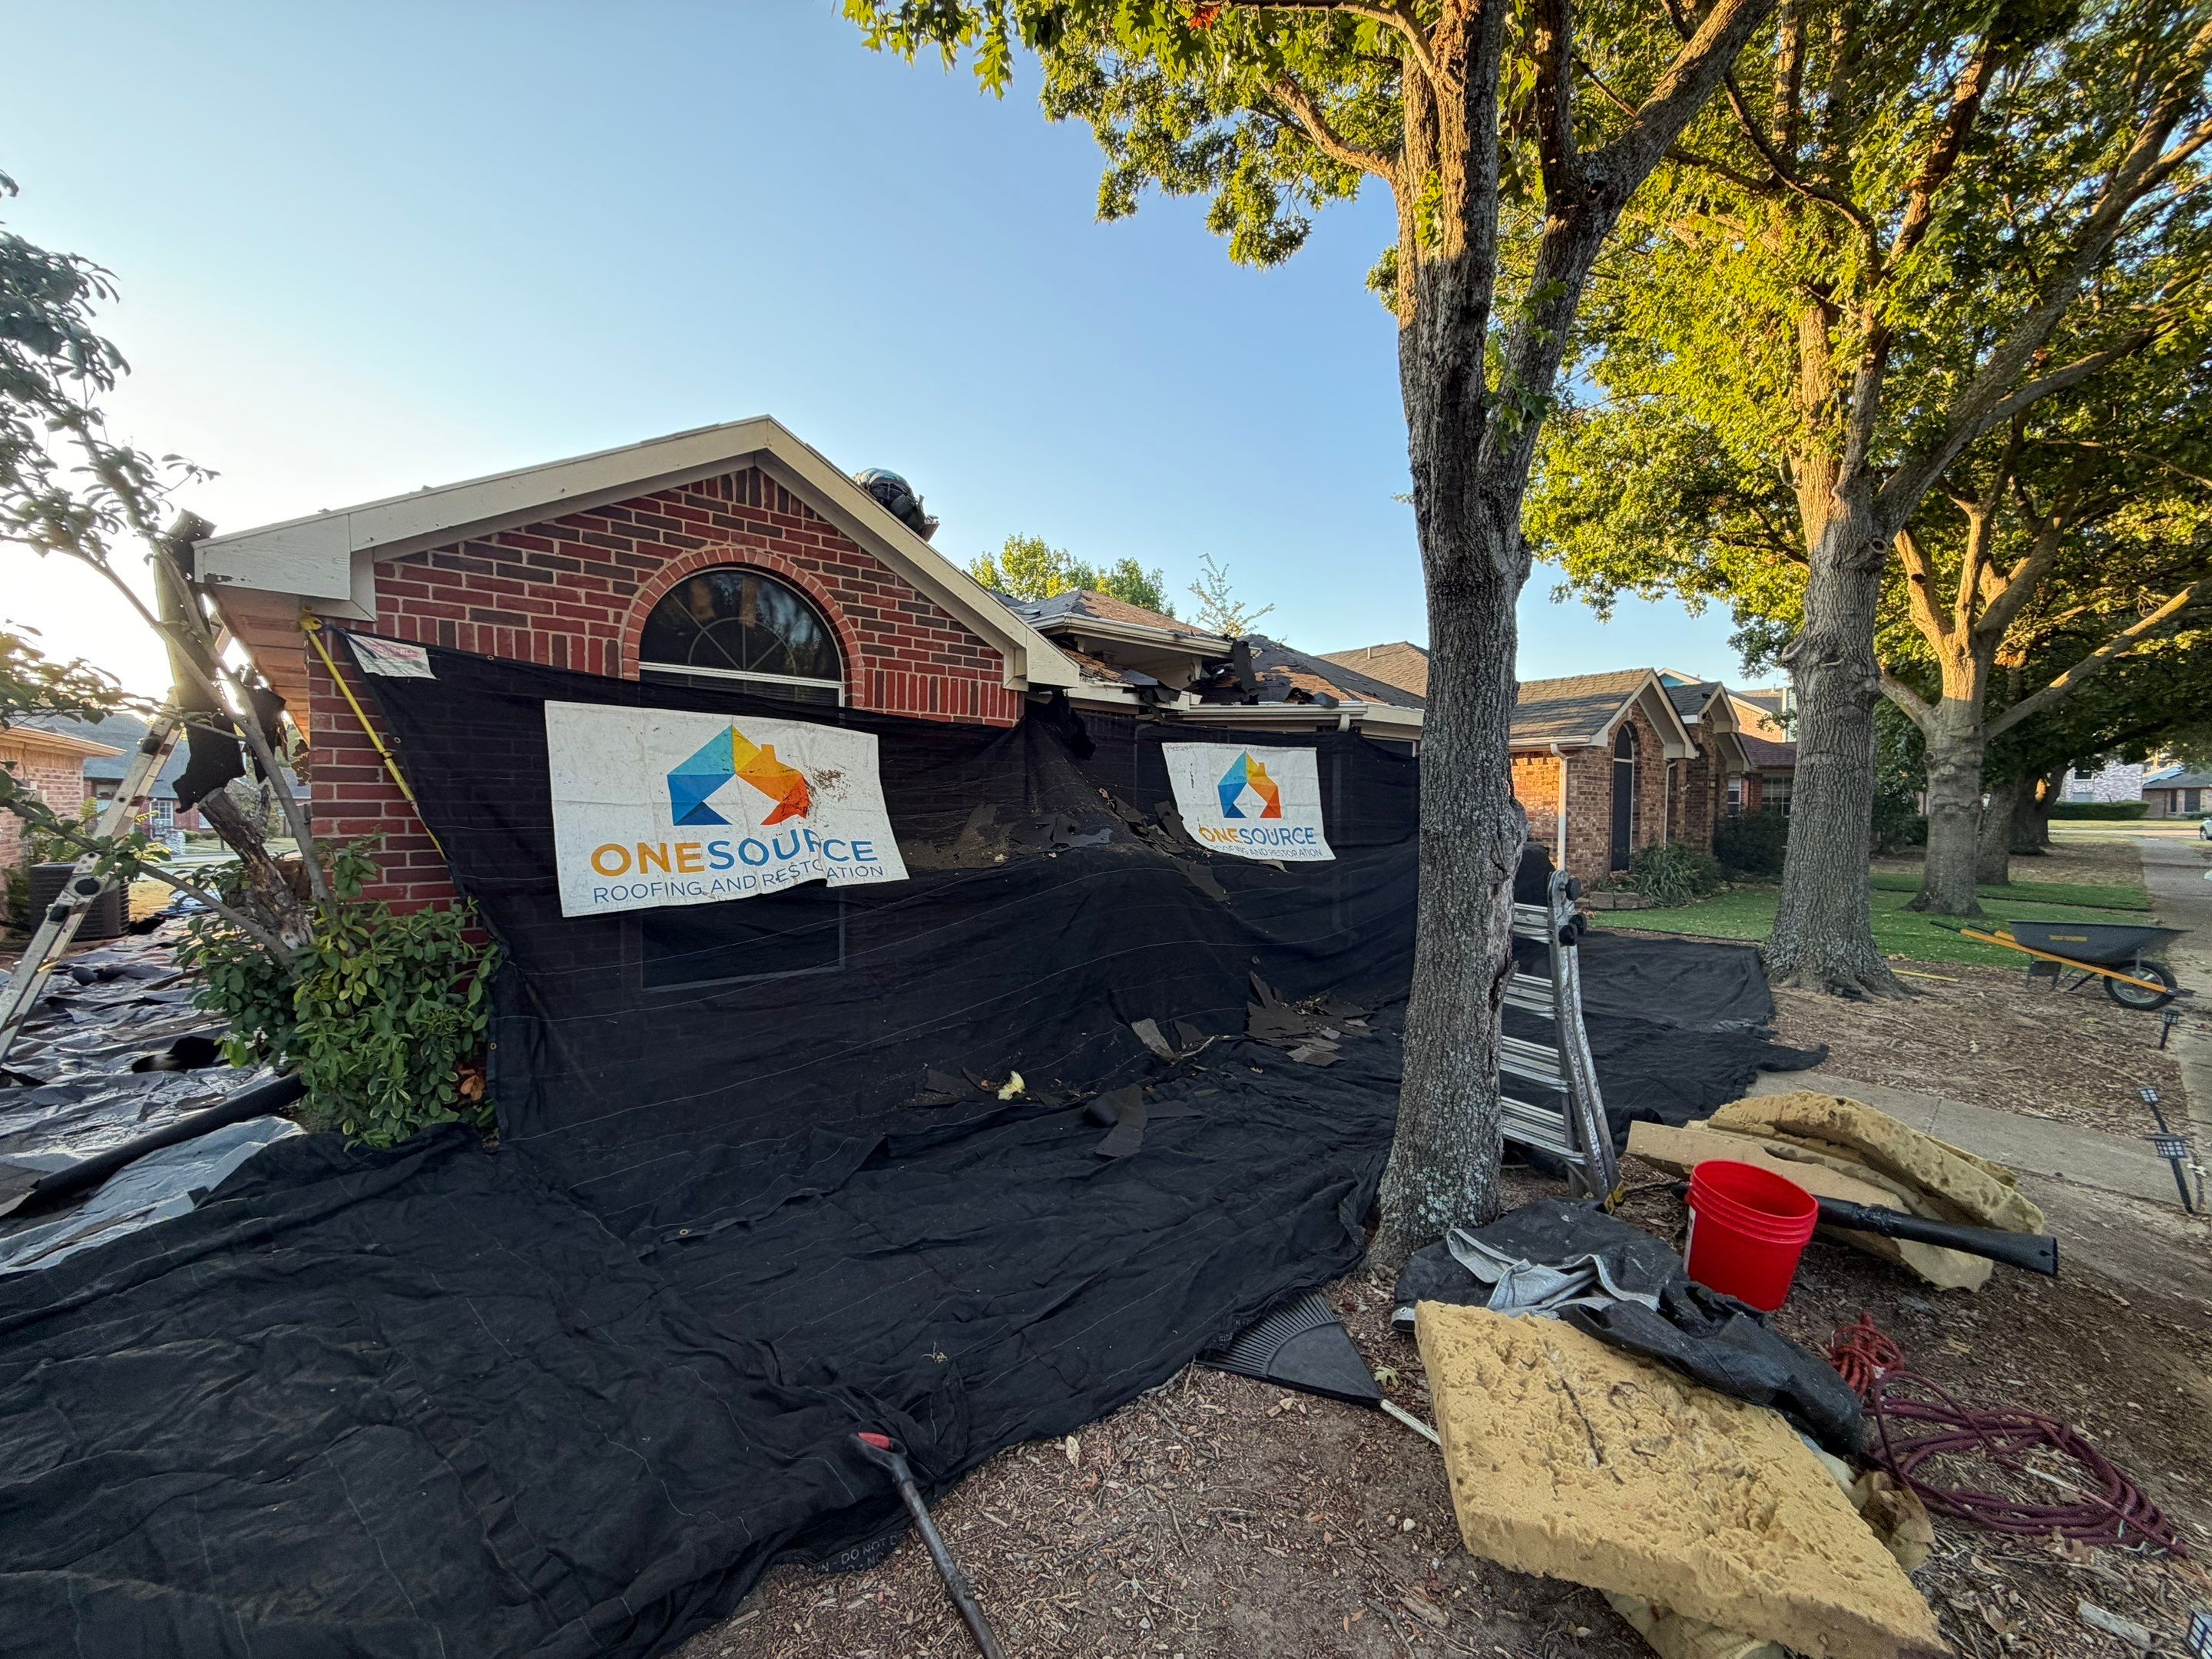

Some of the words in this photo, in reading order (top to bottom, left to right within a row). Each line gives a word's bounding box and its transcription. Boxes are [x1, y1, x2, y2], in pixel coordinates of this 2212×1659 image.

[591, 828, 879, 877] ONESOURCE
[1198, 827, 1317, 846] ONESOURCE
[1249, 848, 1269, 856] AND
[1269, 847, 1323, 857] RESTORATION
[594, 882, 702, 904] ROOFING
[711, 875, 757, 894] AND
[762, 857, 884, 886] RESTOATION
